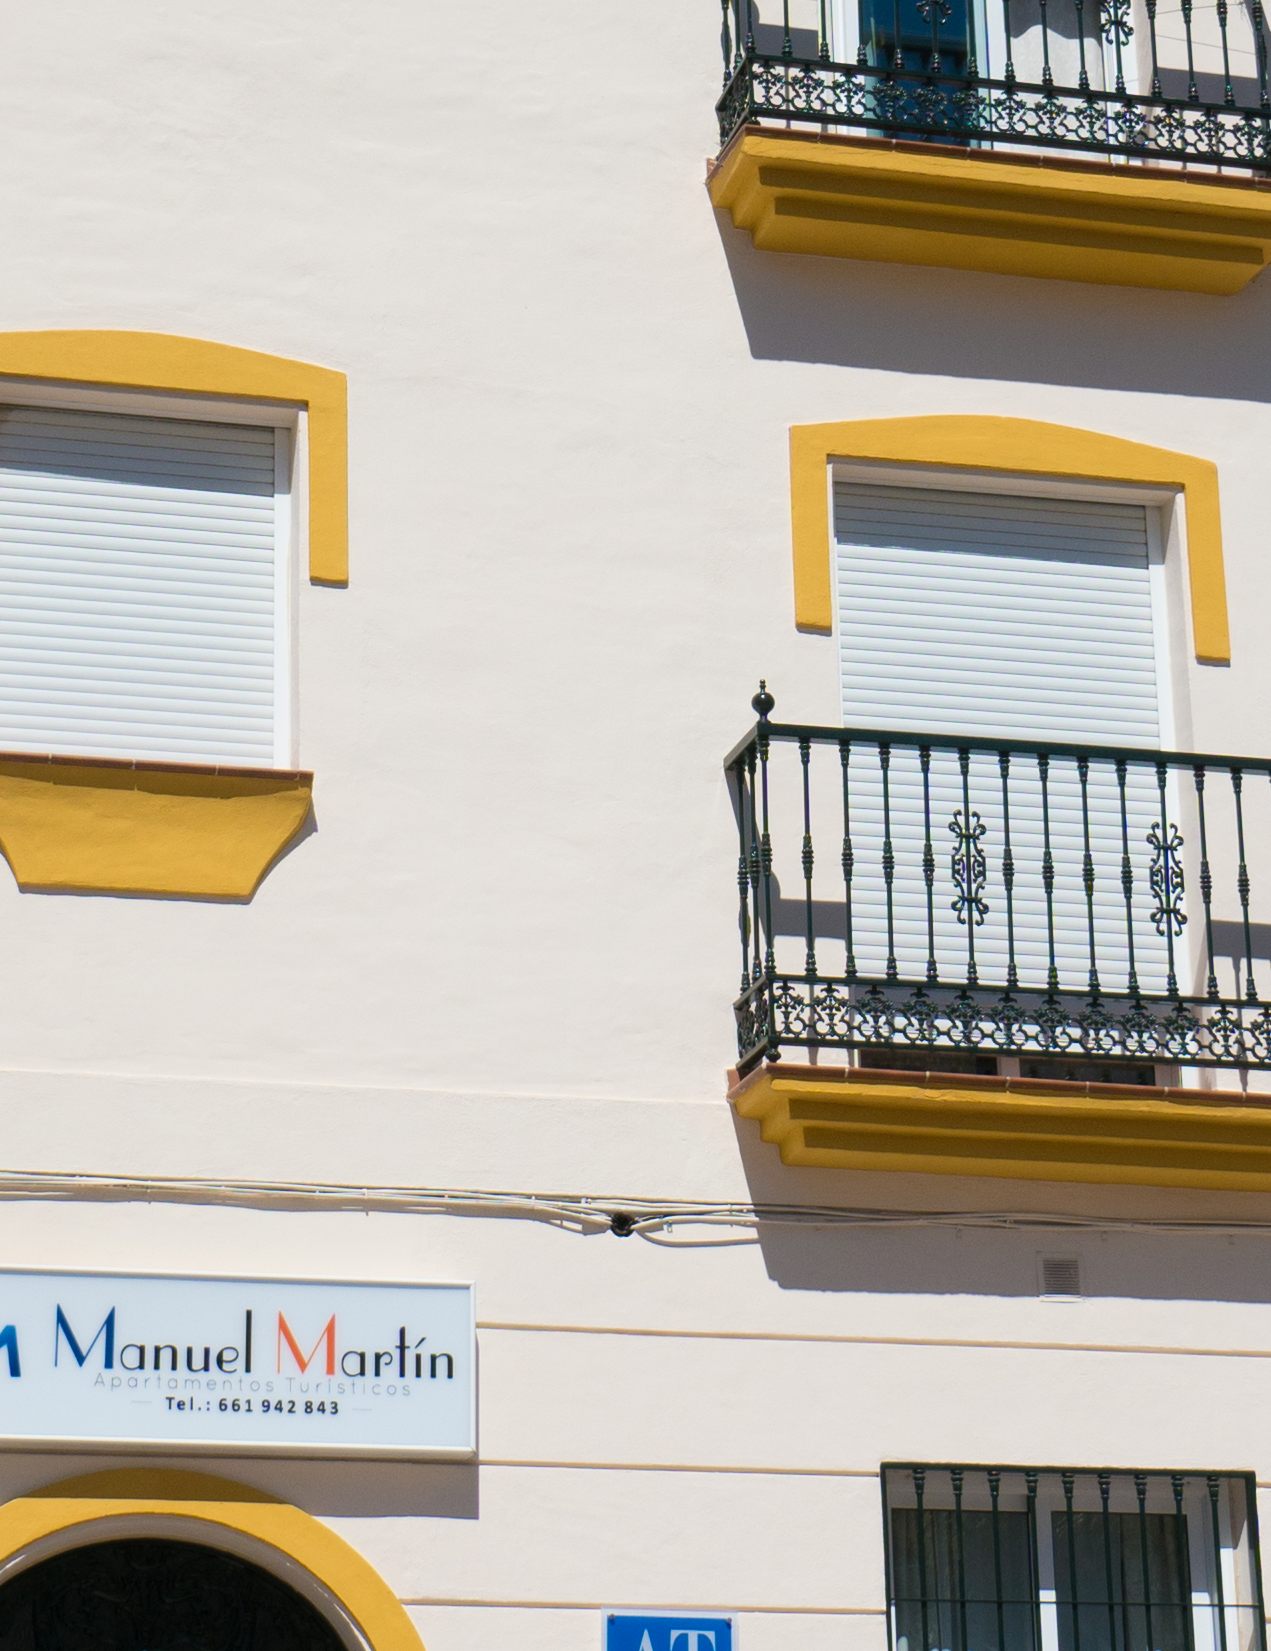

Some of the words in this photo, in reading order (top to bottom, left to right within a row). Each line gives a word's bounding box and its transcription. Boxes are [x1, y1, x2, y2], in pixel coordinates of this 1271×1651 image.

[54, 1303, 252, 1373] Manuel
[277, 1310, 454, 1379] Martín
[94, 1372, 274, 1392] Apartamentos
[166, 1396, 211, 1412] Tel.:
[218, 1398, 253, 1413] 661
[261, 1399, 296, 1414] 942
[304, 1401, 339, 1415] 843
